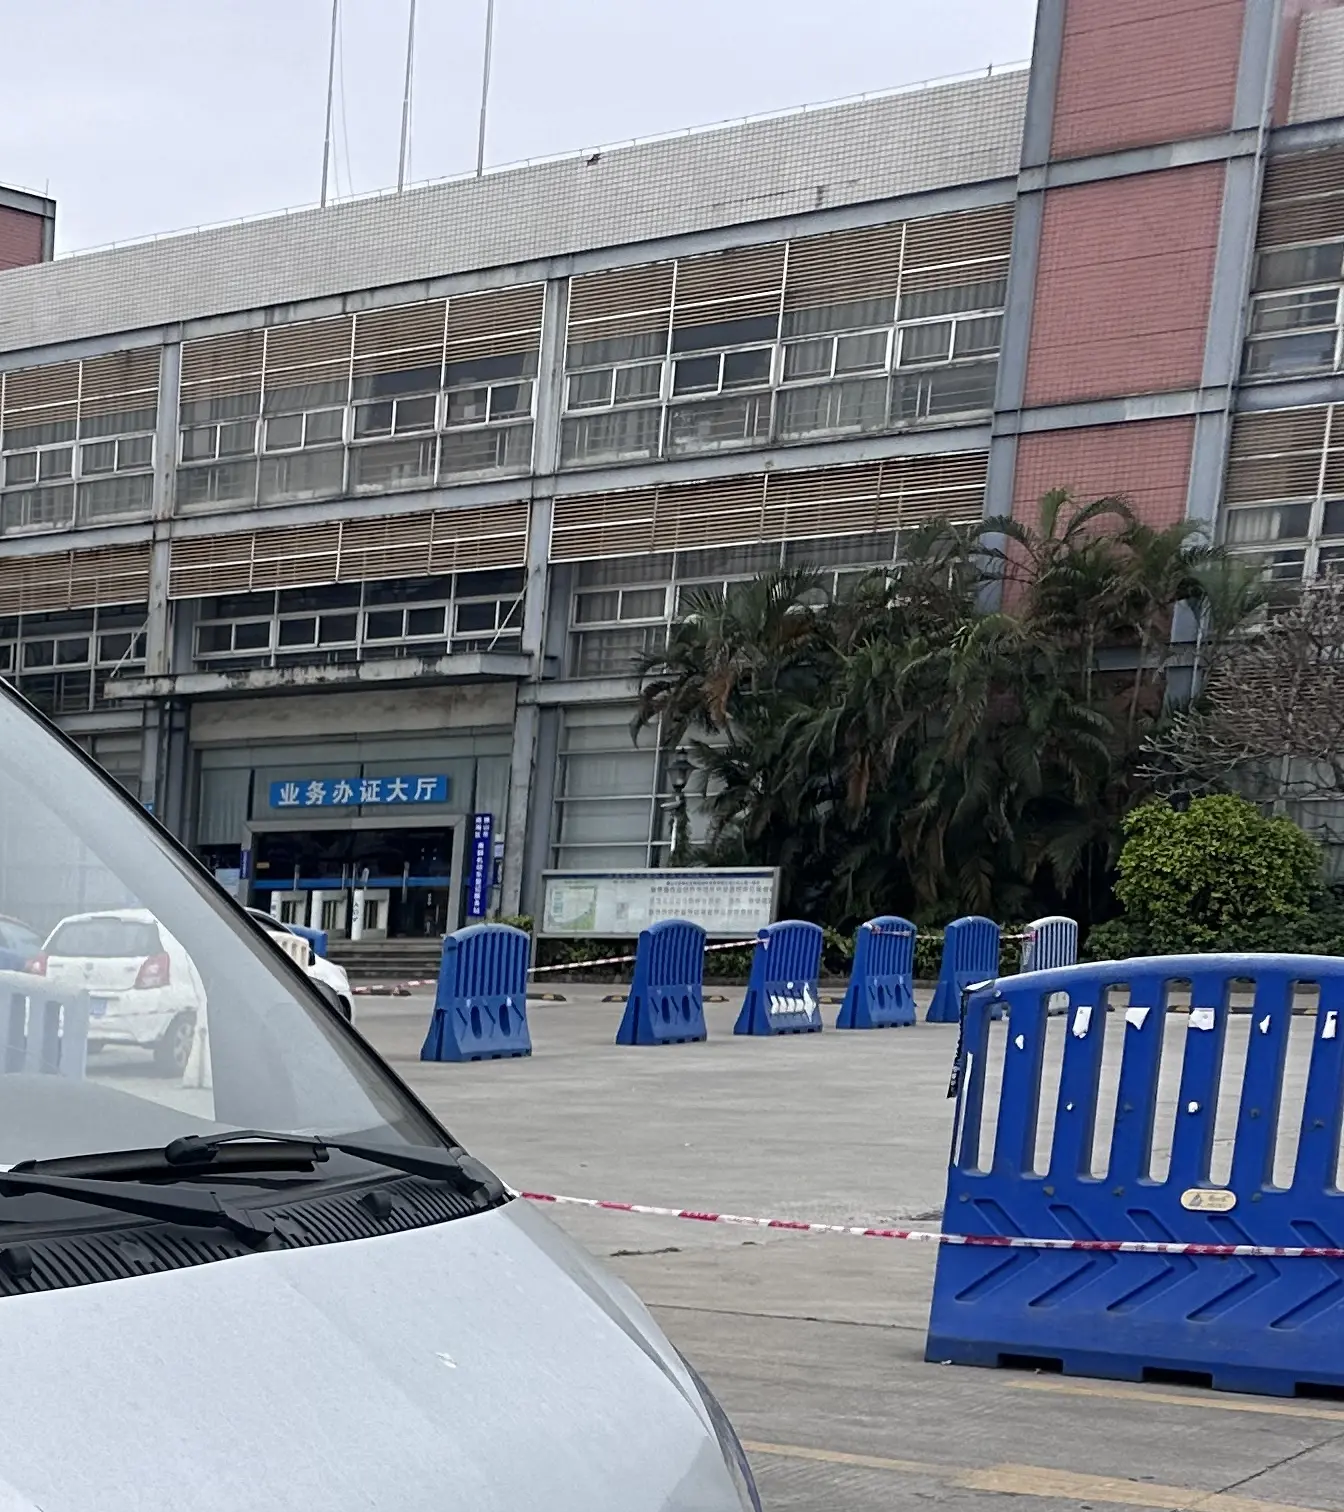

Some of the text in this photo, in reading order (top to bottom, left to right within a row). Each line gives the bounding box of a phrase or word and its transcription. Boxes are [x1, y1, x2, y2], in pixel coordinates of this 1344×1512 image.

[277, 776, 439, 807] 业务办证大厅
